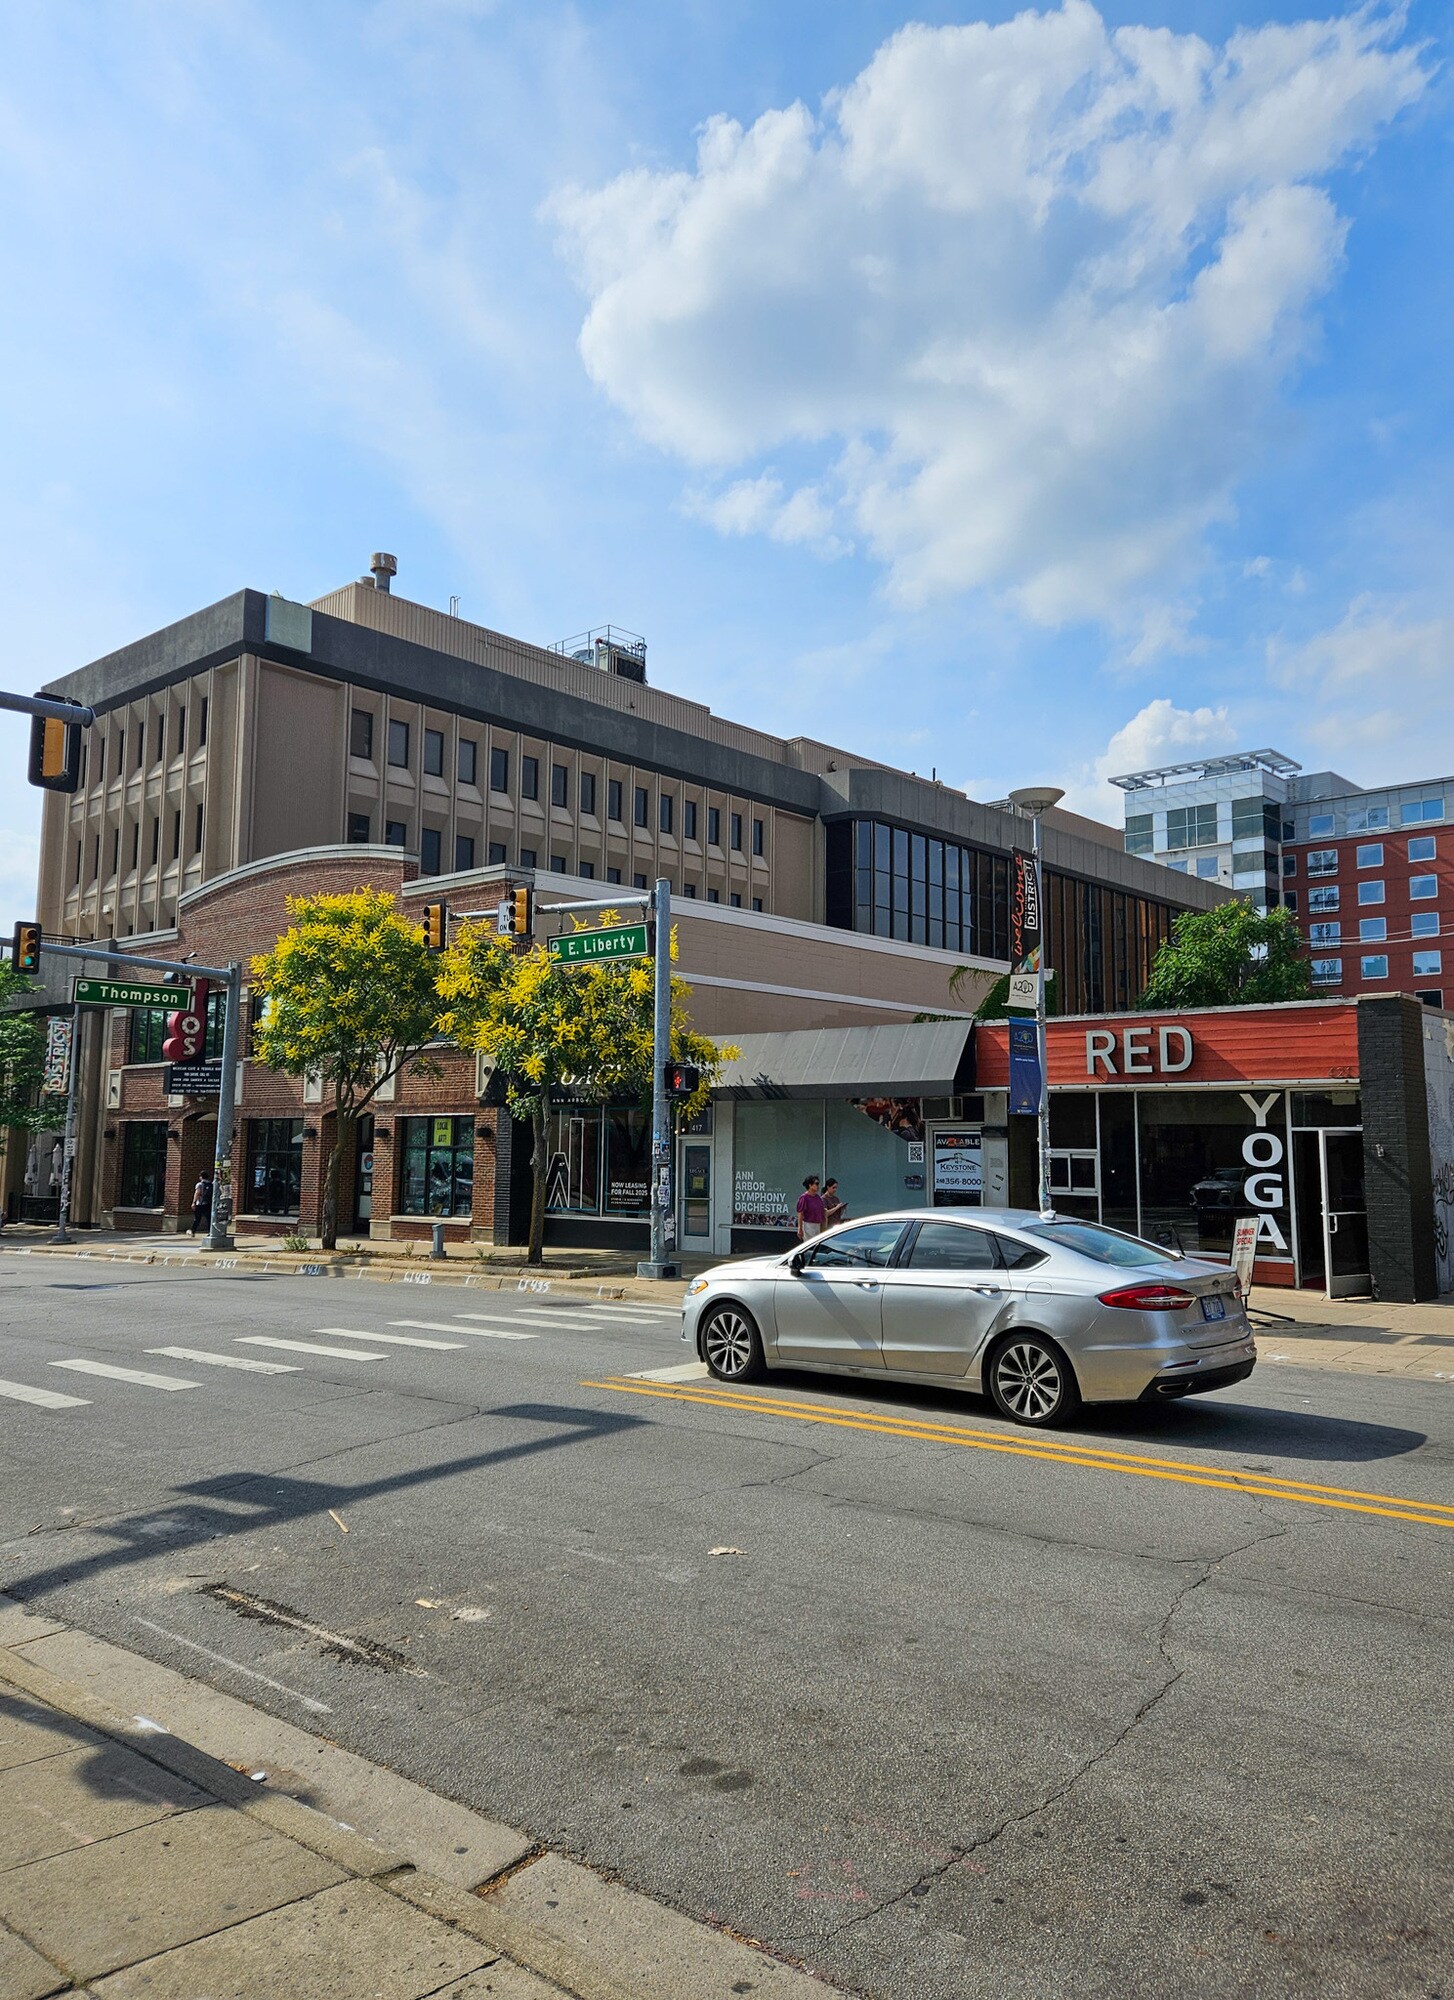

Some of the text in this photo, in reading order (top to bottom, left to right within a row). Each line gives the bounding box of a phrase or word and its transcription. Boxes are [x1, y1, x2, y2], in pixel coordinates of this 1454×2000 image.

[1026, 862, 1036, 926] DISTRICT
[1012, 854, 1024, 956] welcome
[568, 934, 635, 956] E. Liberty
[100, 986, 178, 1004] Thompson
[50, 1024, 66, 1088] DISTRICT
[1086, 1026, 1193, 1074] RED
[735, 1172, 754, 1180] ANN
[1239, 1093, 1288, 1250] YOGA
[735, 1182, 765, 1191] ARBOR
[735, 1192, 786, 1202] SYMPHONY
[735, 1202, 789, 1213] ORCHESTRA
[1237, 1228, 1255, 1236] SUMMER
